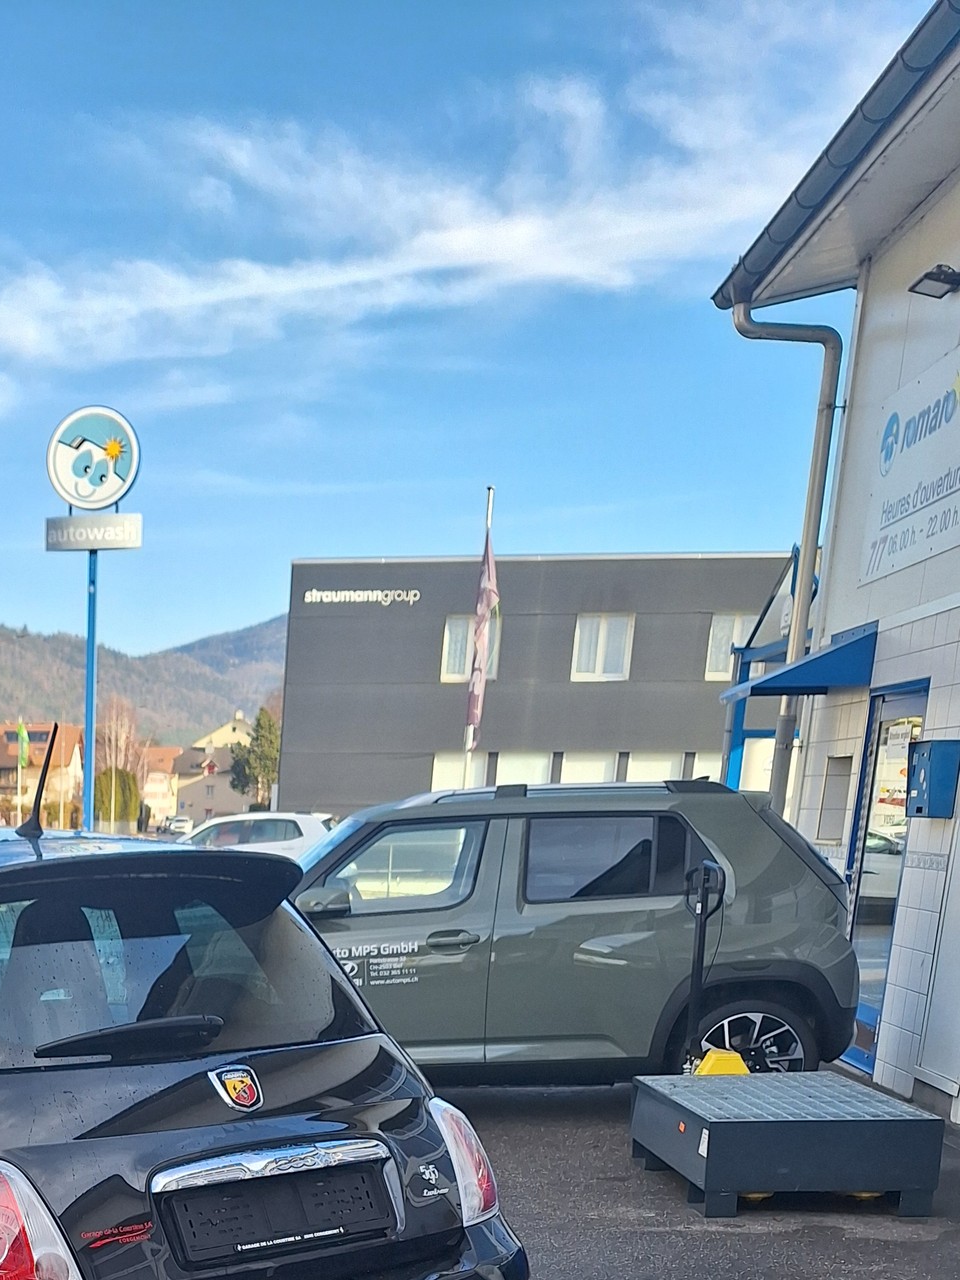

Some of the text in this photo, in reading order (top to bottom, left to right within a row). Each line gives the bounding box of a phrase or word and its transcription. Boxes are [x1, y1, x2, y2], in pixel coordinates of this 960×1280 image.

[880, 493, 911, 525] Heures
[47, 520, 137, 543] autowash
[304, 588, 421, 606] straumanngroup
[351, 945, 378, 957] MPS
[380, 940, 419, 955] GmbH
[420, 1164, 439, 1184] 595
[81, 1230, 103, 1239] Garage
